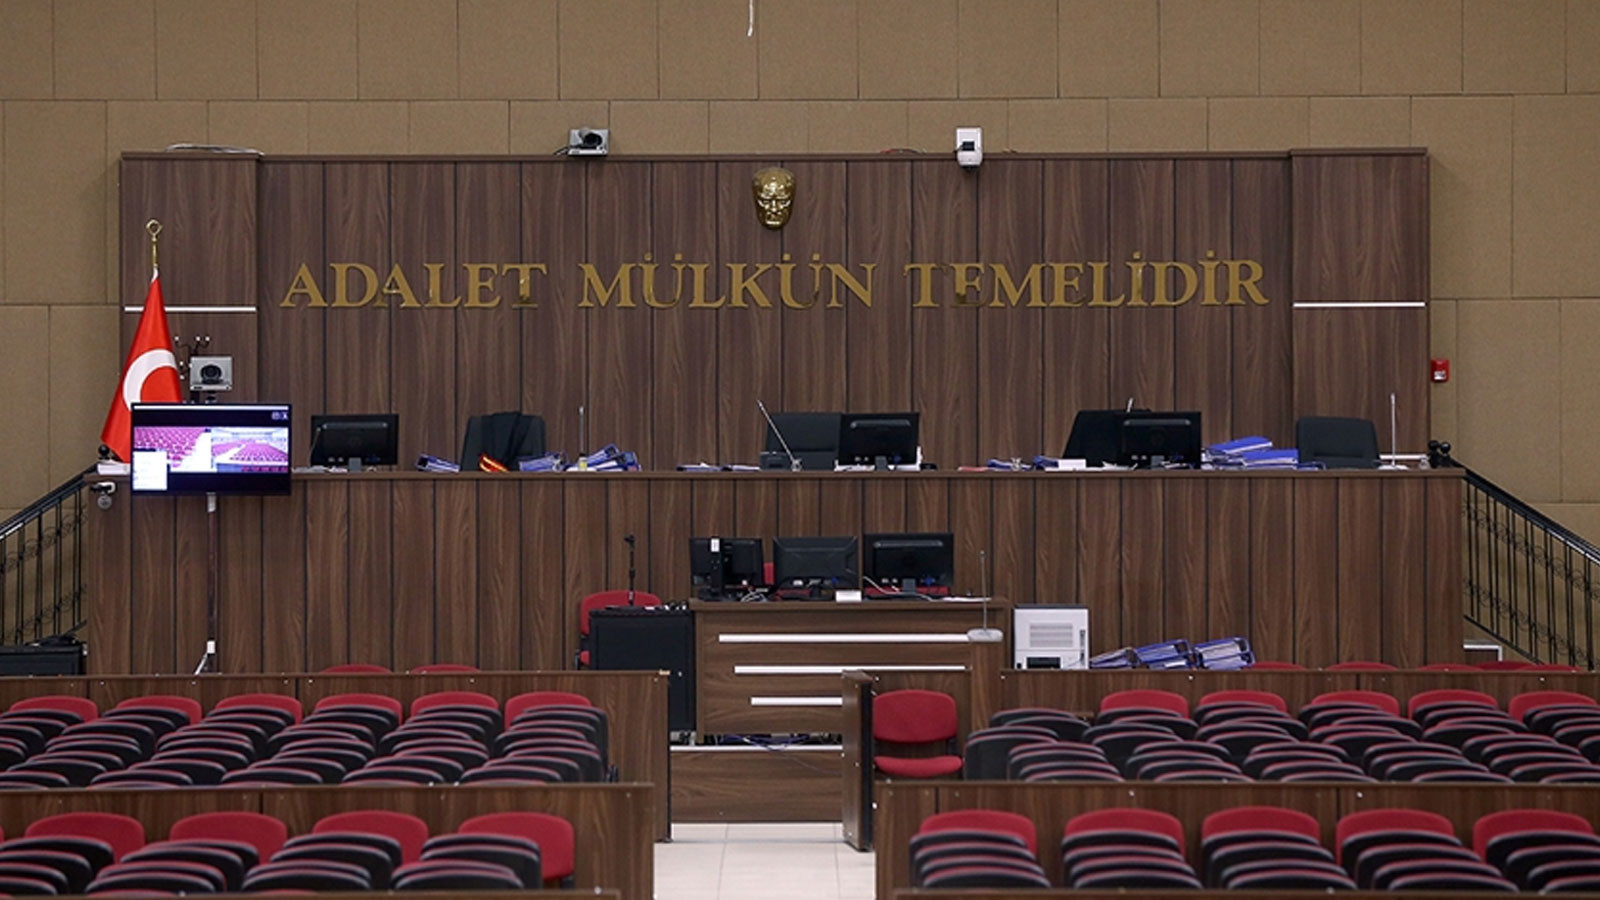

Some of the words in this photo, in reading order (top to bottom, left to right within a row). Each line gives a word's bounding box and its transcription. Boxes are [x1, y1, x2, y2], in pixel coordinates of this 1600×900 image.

[280, 263, 547, 308] ADALET
[577, 252, 877, 309] MÜLKÜN
[903, 250, 1270, 308] TEMELİDİR
